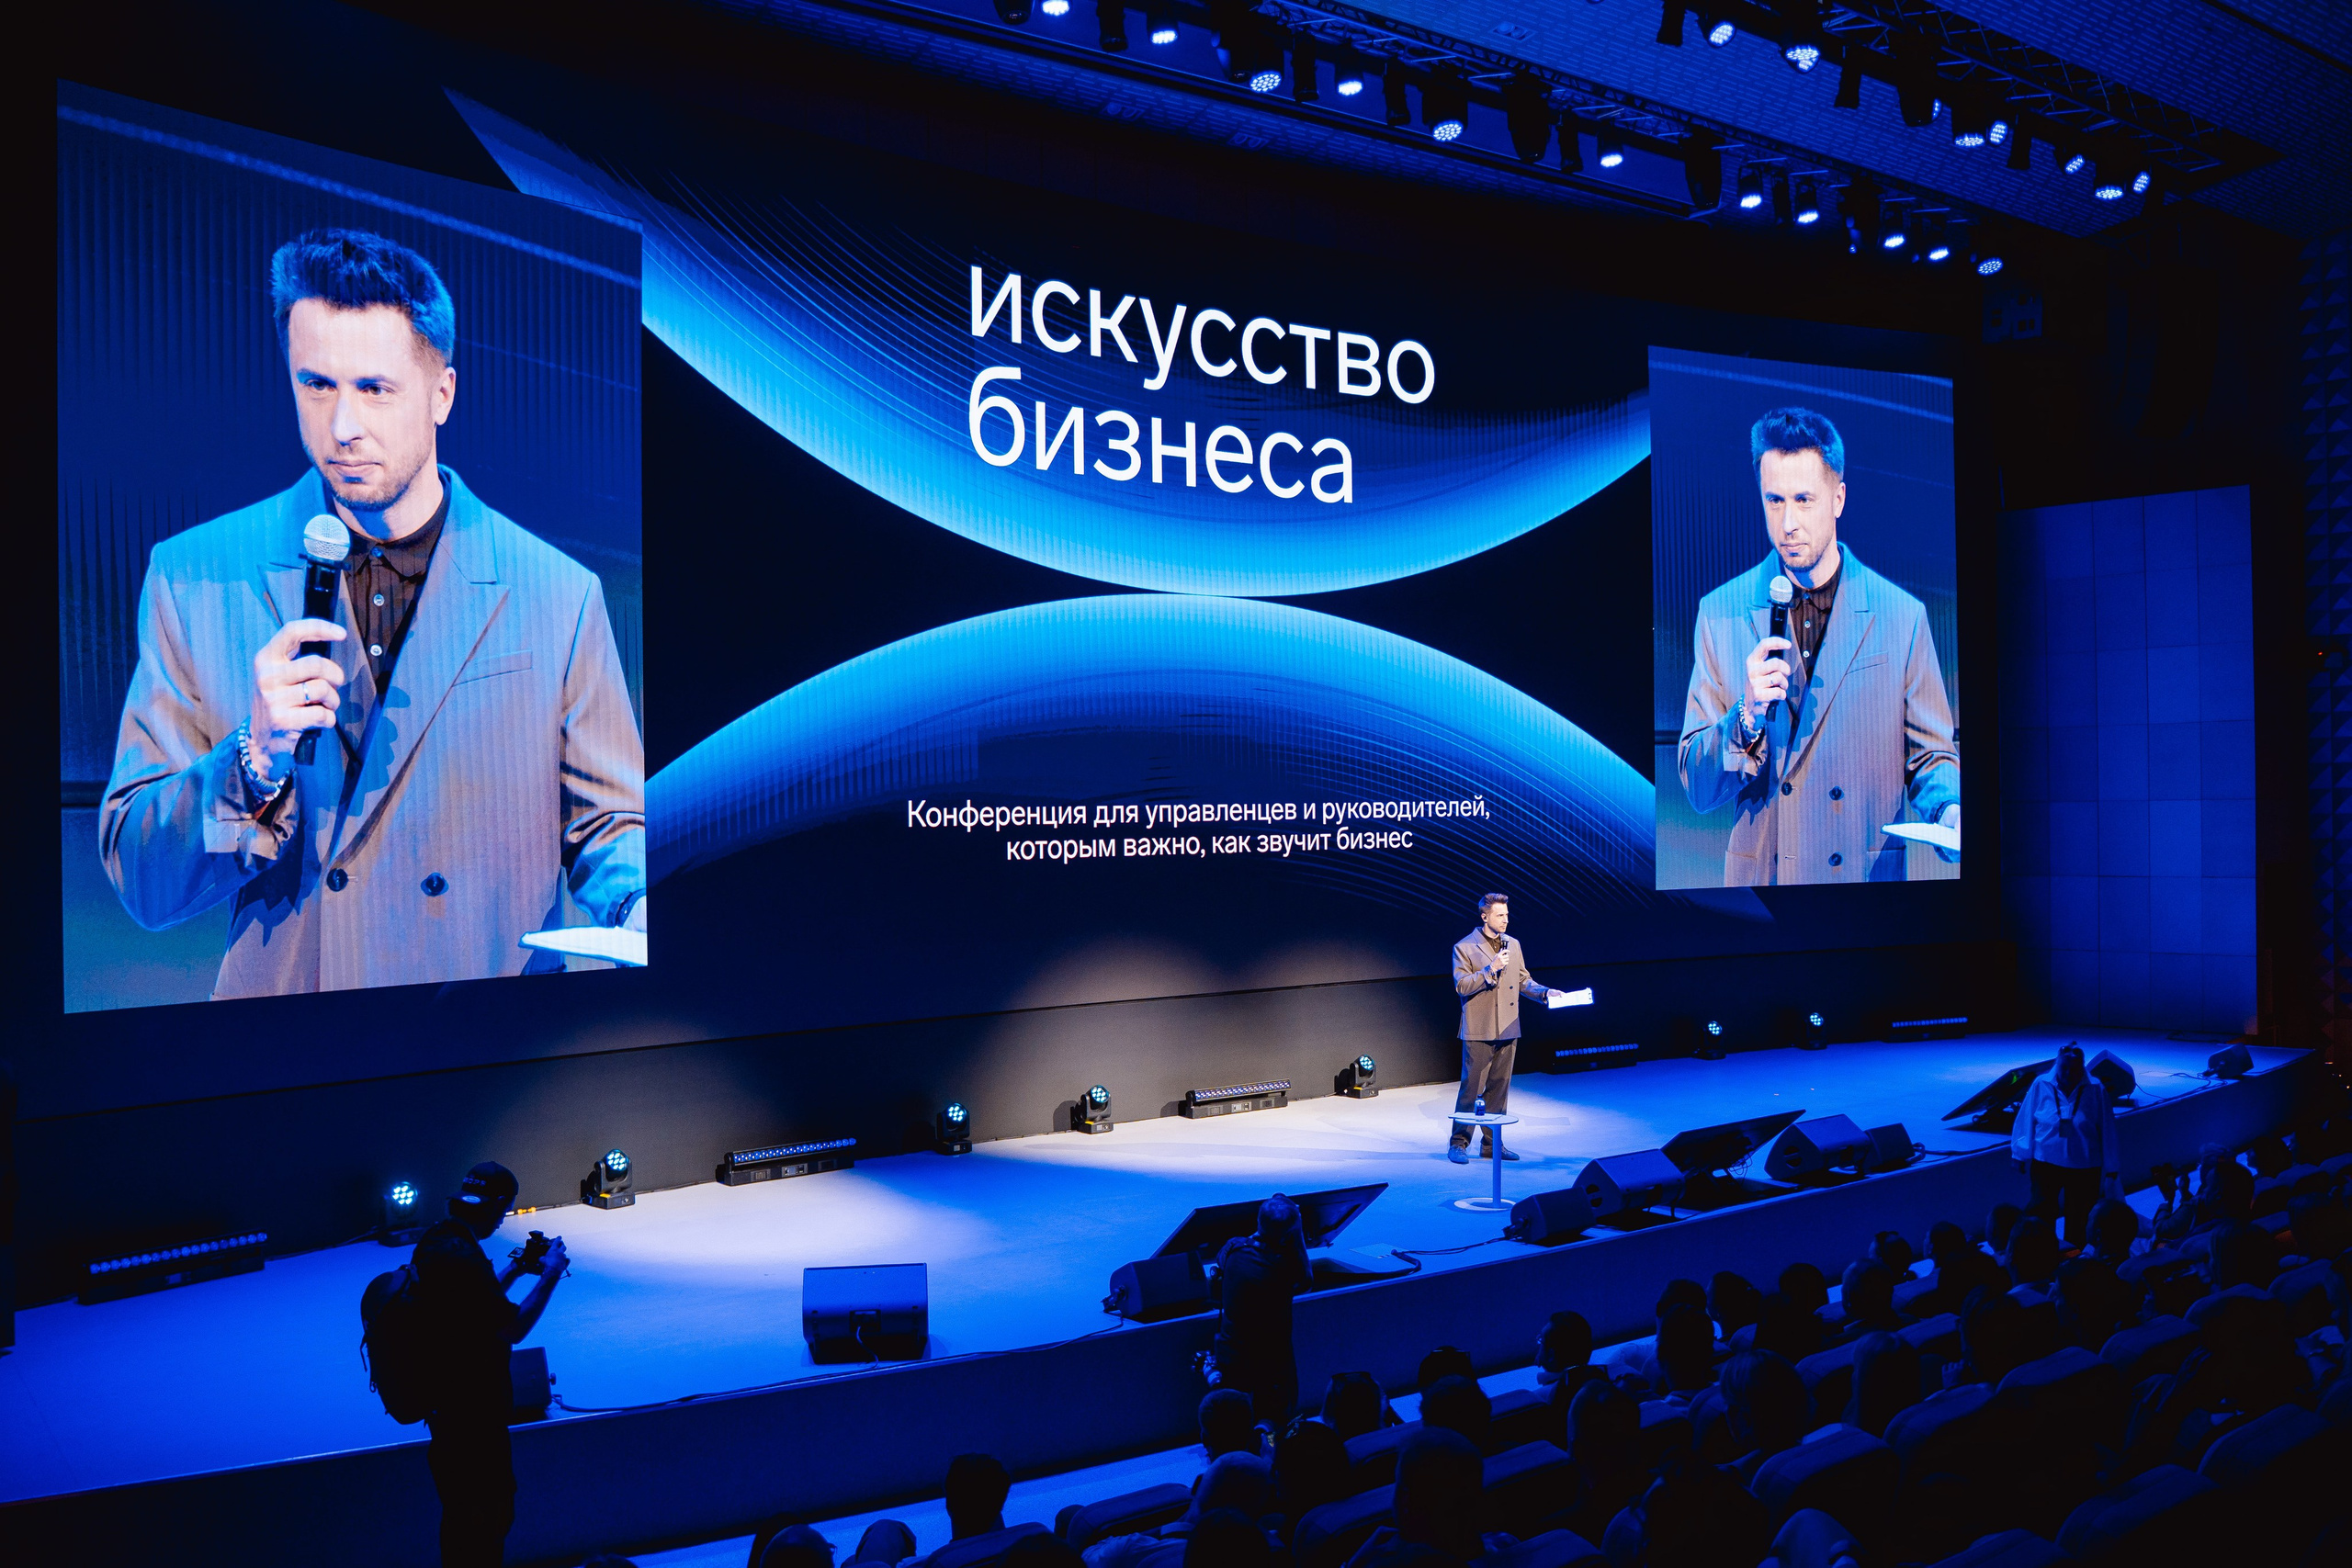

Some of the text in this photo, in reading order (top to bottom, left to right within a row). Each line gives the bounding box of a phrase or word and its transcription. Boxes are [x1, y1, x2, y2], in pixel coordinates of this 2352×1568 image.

[971, 265, 1436, 405] искусство
[967, 365, 1354, 504] бизнеса
[907, 795, 1491, 833] Конференция для управленцев и руководителей,
[1006, 825, 1414, 865] которым важно, как звучит бизнес
